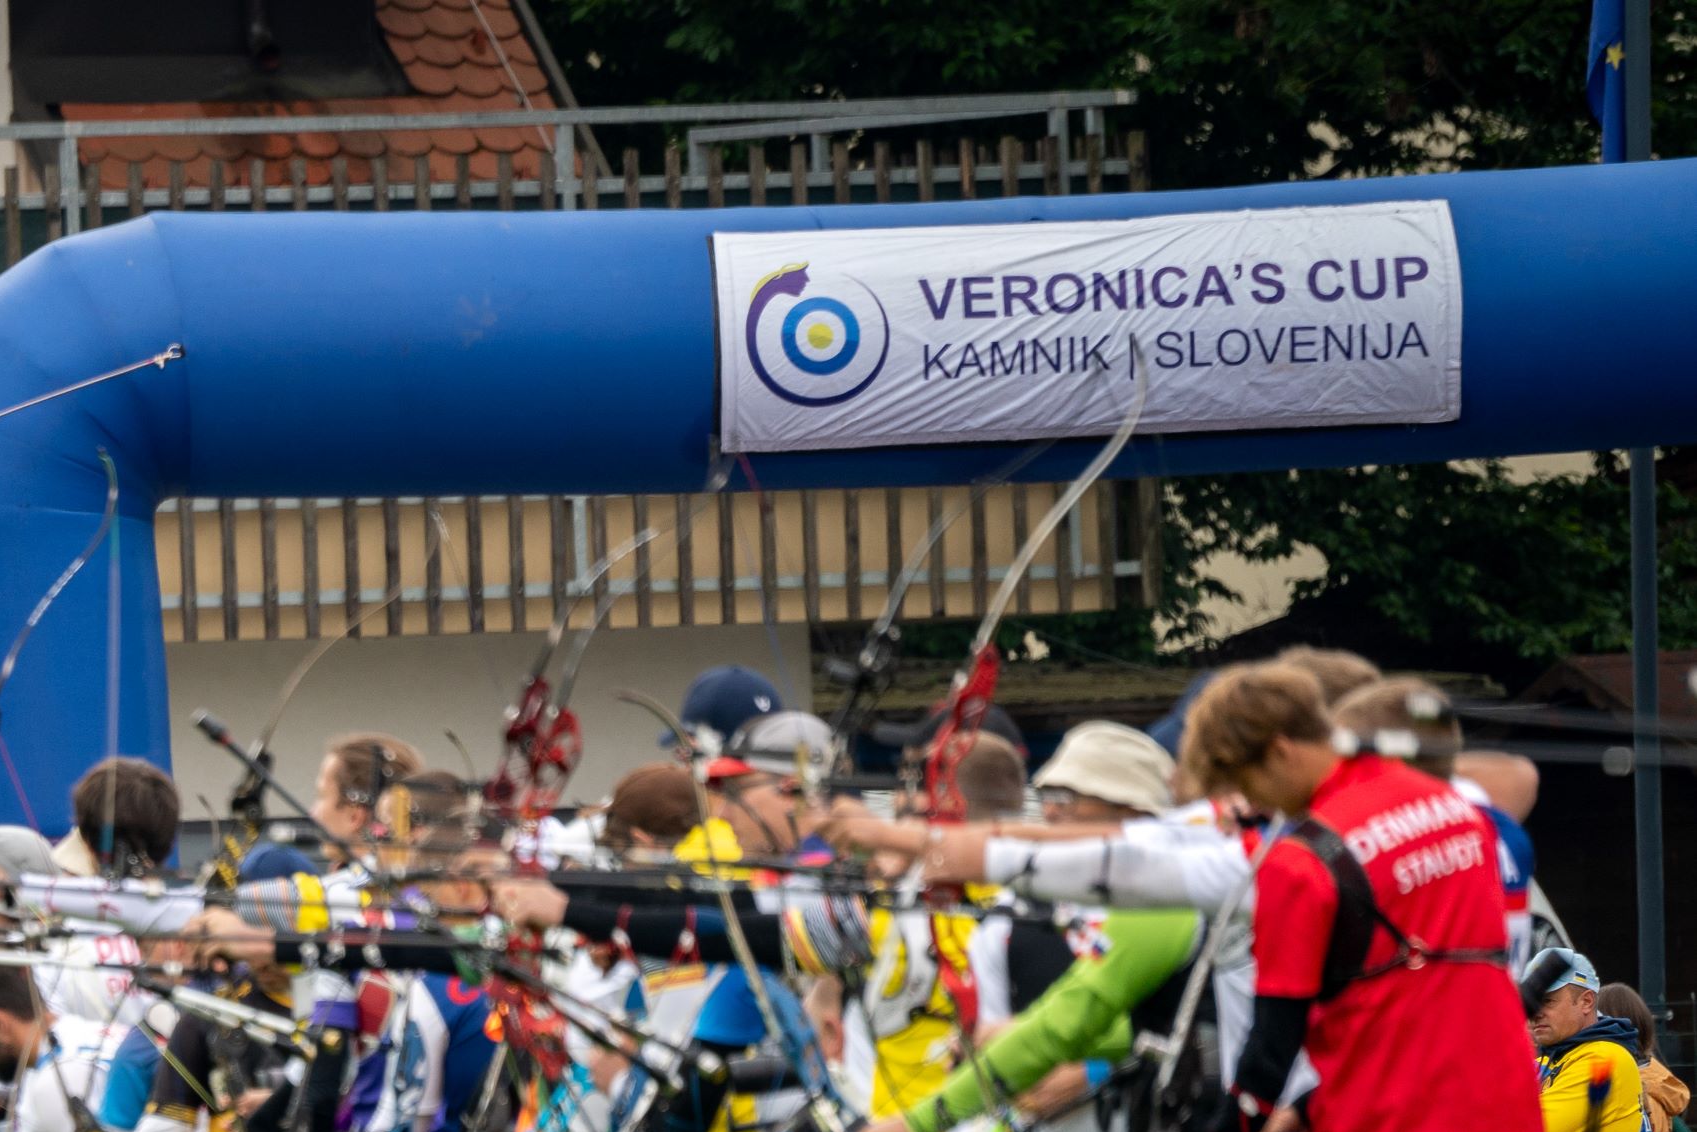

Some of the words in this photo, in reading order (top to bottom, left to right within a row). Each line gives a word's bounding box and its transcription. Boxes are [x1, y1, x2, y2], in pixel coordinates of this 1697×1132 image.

[918, 262, 1285, 320] VERONICA'S
[1307, 255, 1429, 302] CUP
[922, 334, 1112, 381] KAMNIK
[1155, 321, 1429, 368] SLOVENIJA
